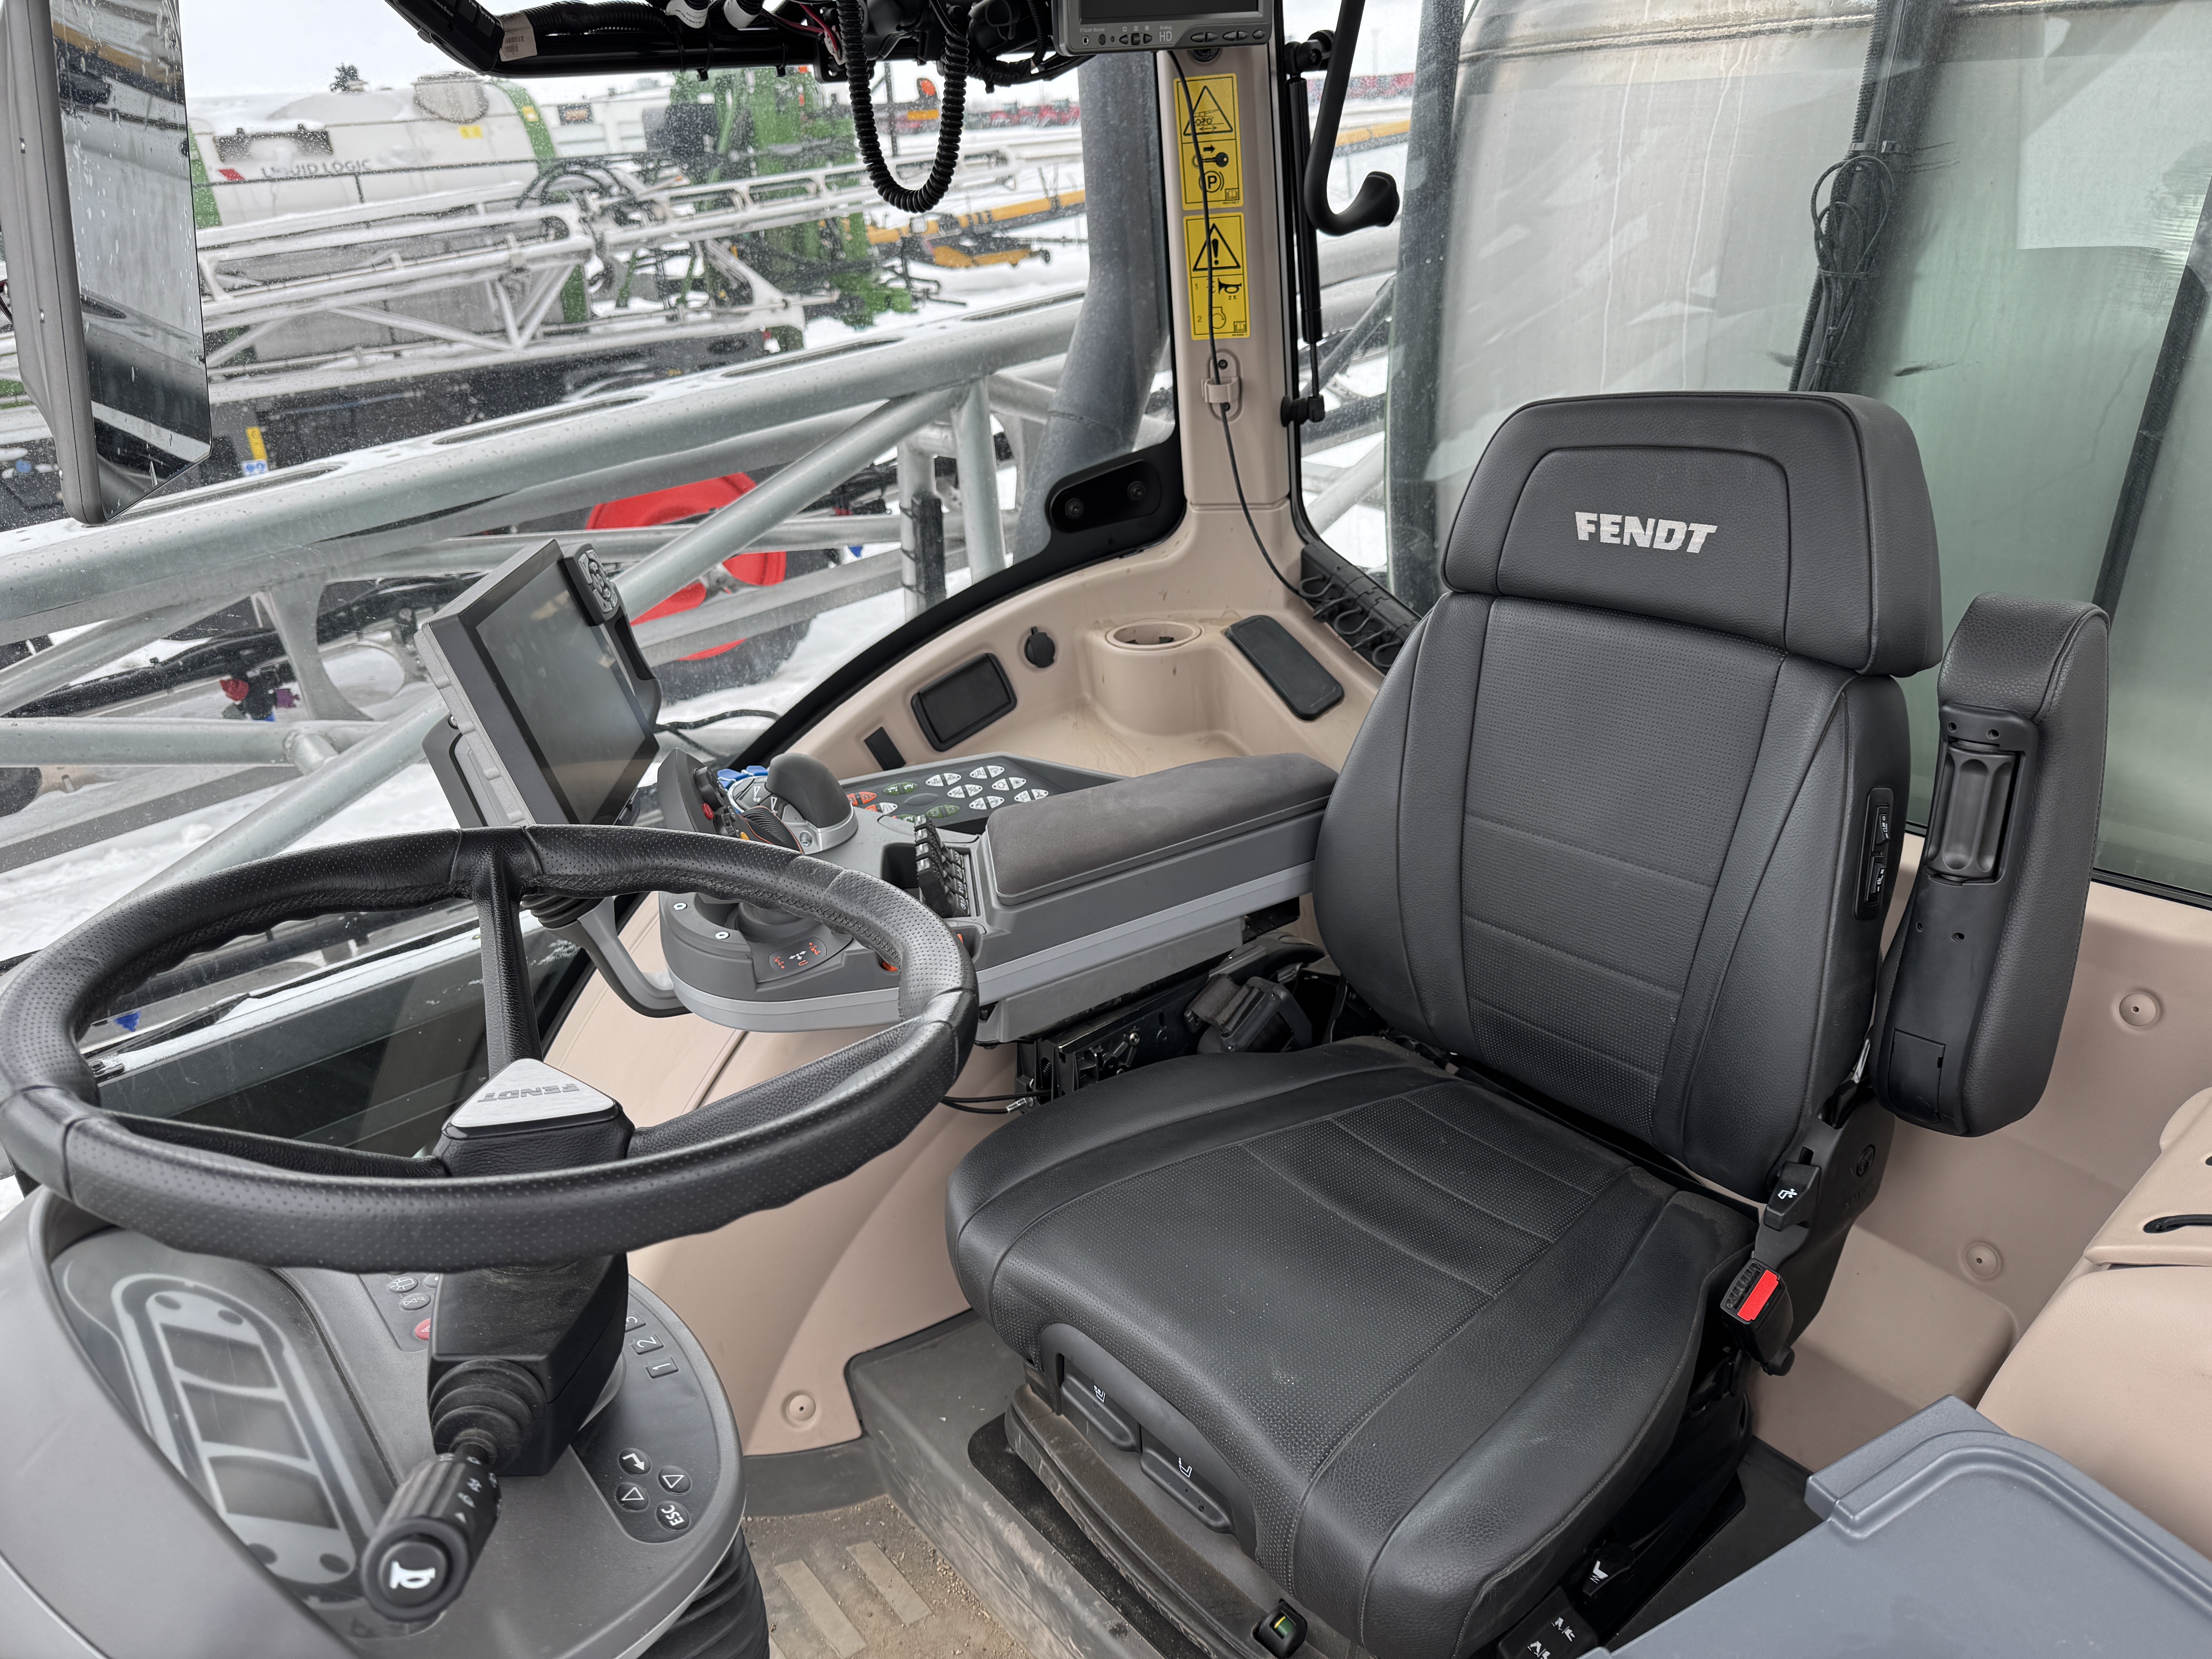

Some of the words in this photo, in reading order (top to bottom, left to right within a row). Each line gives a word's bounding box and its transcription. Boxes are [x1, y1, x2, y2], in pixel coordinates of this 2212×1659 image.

[1159, 31, 1172, 41] HD
[322, 158, 373, 173] LOGIC
[1207, 175, 1217, 189] P
[1575, 512, 1718, 553] FENDT
[477, 1084, 580, 1102] FENDT
[637, 1336, 657, 1348] 2
[661, 1505, 684, 1526] ESC
